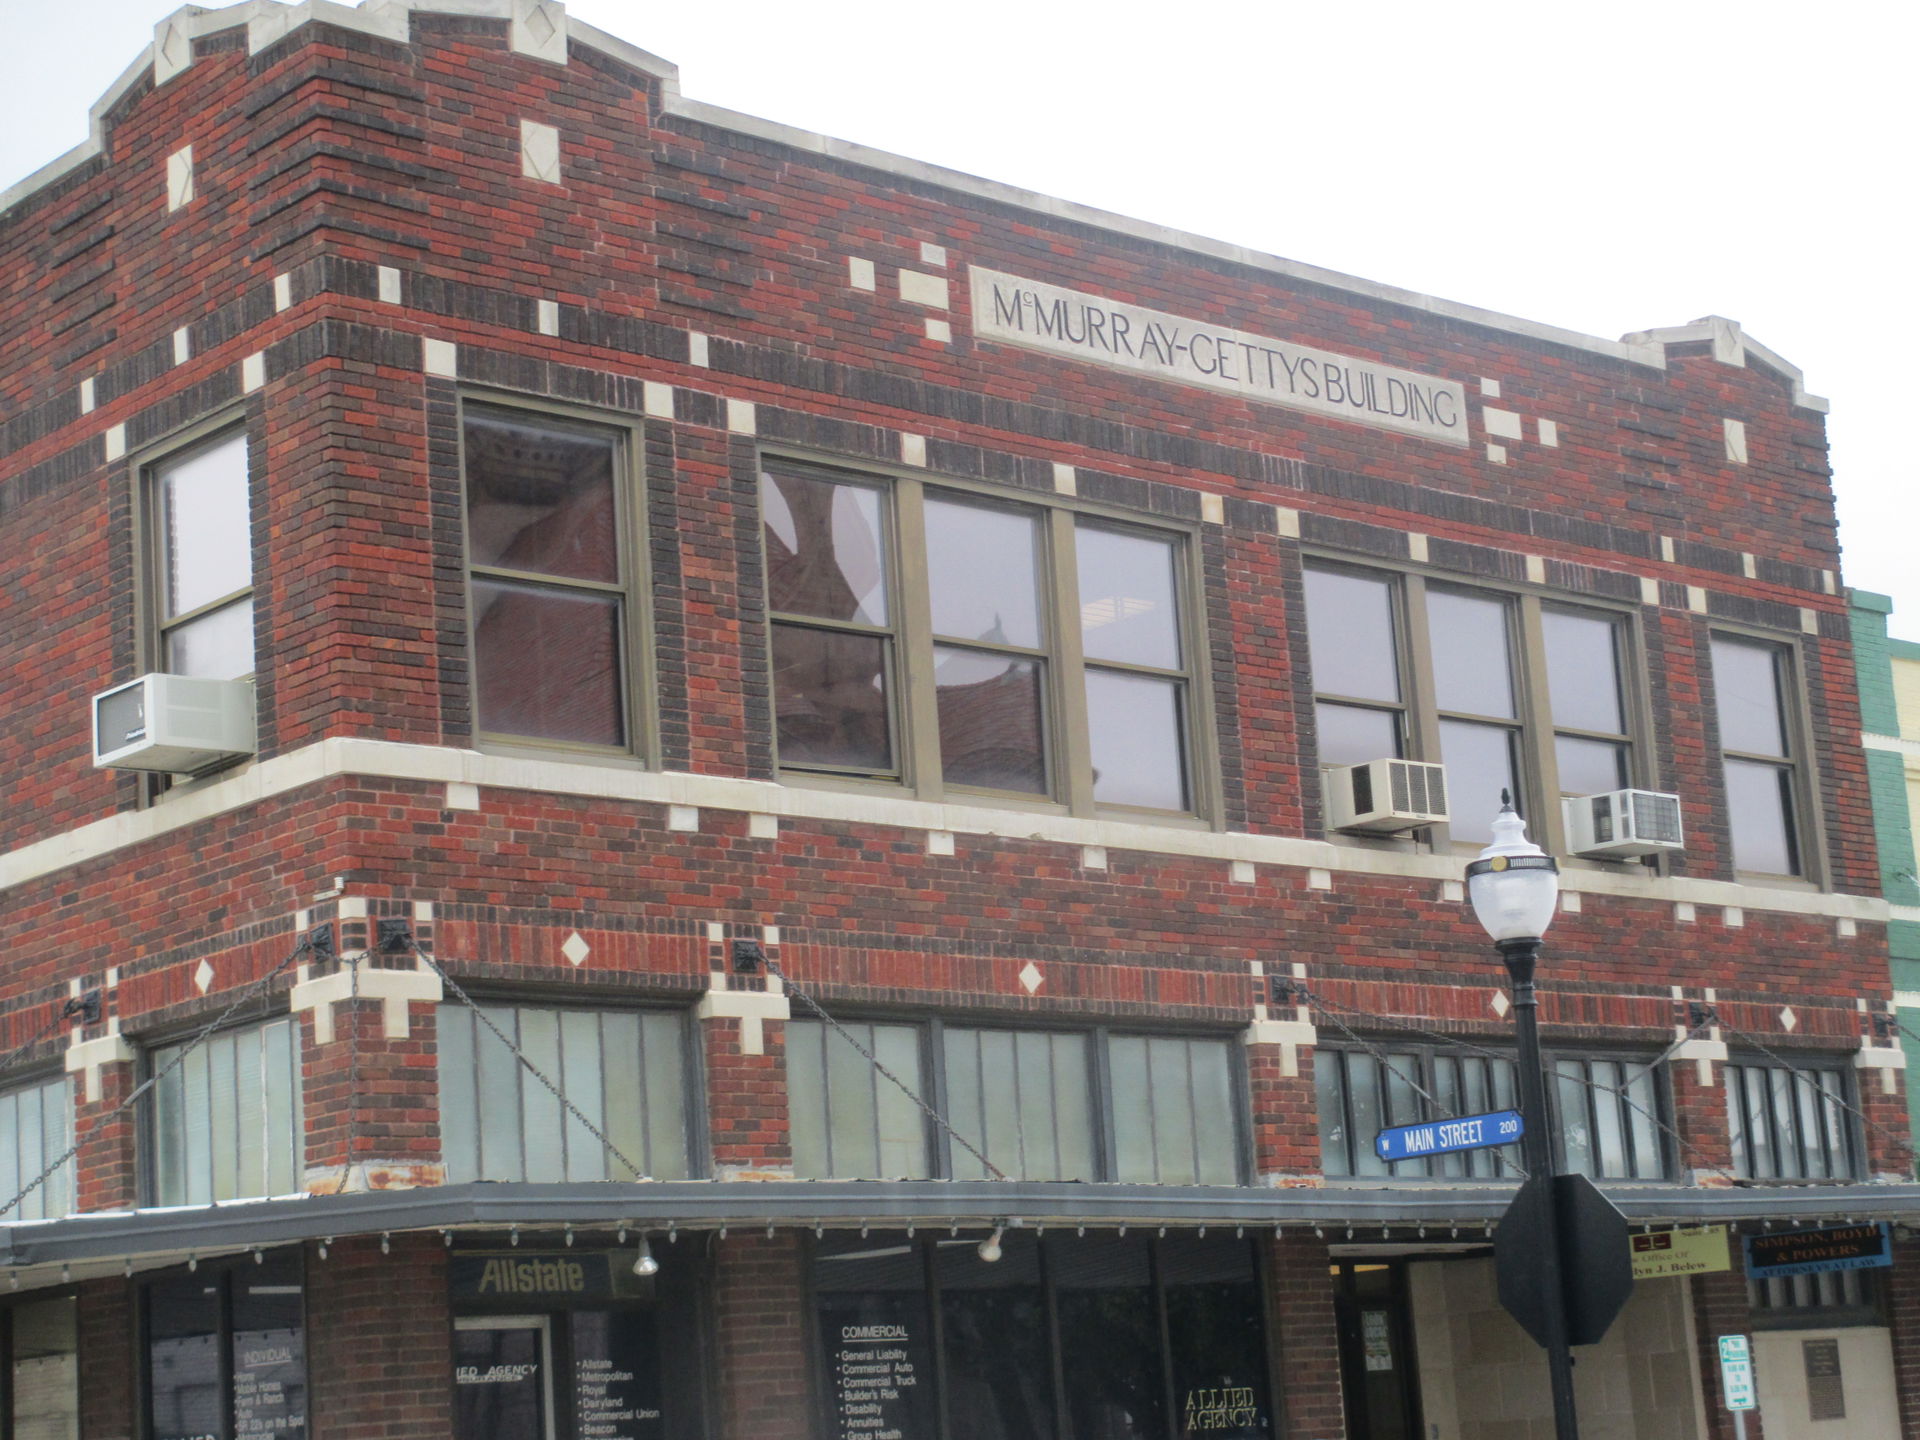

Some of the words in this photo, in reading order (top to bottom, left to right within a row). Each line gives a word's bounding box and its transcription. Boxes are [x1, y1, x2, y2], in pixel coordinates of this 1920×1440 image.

[1325, 362, 1457, 428] BUILDING
[1382, 1140, 1389, 1151] W
[1404, 1127, 1434, 1153] MAIN
[1439, 1119, 1482, 1148] STREET
[1498, 1119, 1517, 1134] 200
[1832, 1226, 1877, 1241] BOYD
[1792, 1245, 1859, 1261] POWERS
[478, 1258, 585, 1293] Allstate
[842, 1325, 909, 1339] COMMERCIAL
[841, 1350, 874, 1361] General
[876, 1349, 907, 1361] Liability
[487, 1364, 538, 1375] AGENCY
[582, 1359, 613, 1369] Allstate
[842, 1362, 890, 1375] Commercial
[894, 1362, 914, 1373] Auto
[582, 1370, 633, 1384] Metropolitan
[843, 1375, 891, 1388] Commercial
[896, 1375, 917, 1386] Truck
[582, 1384, 607, 1398] Royal
[844, 1389, 878, 1401] Builder's
[881, 1388, 899, 1400] Risk
[583, 1397, 623, 1410] Dairyland
[1186, 1387, 1255, 1410] ALLIED
[583, 1409, 634, 1421] Commercial
[636, 1408, 660, 1420] Union
[845, 1403, 882, 1416] Disability
[847, 1416, 884, 1428] Annuities
[1187, 1407, 1257, 1431] AGENCY
[583, 1423, 617, 1436] Beacon
[847, 1430, 873, 1440] Group
[875, 1429, 902, 1440] Health
